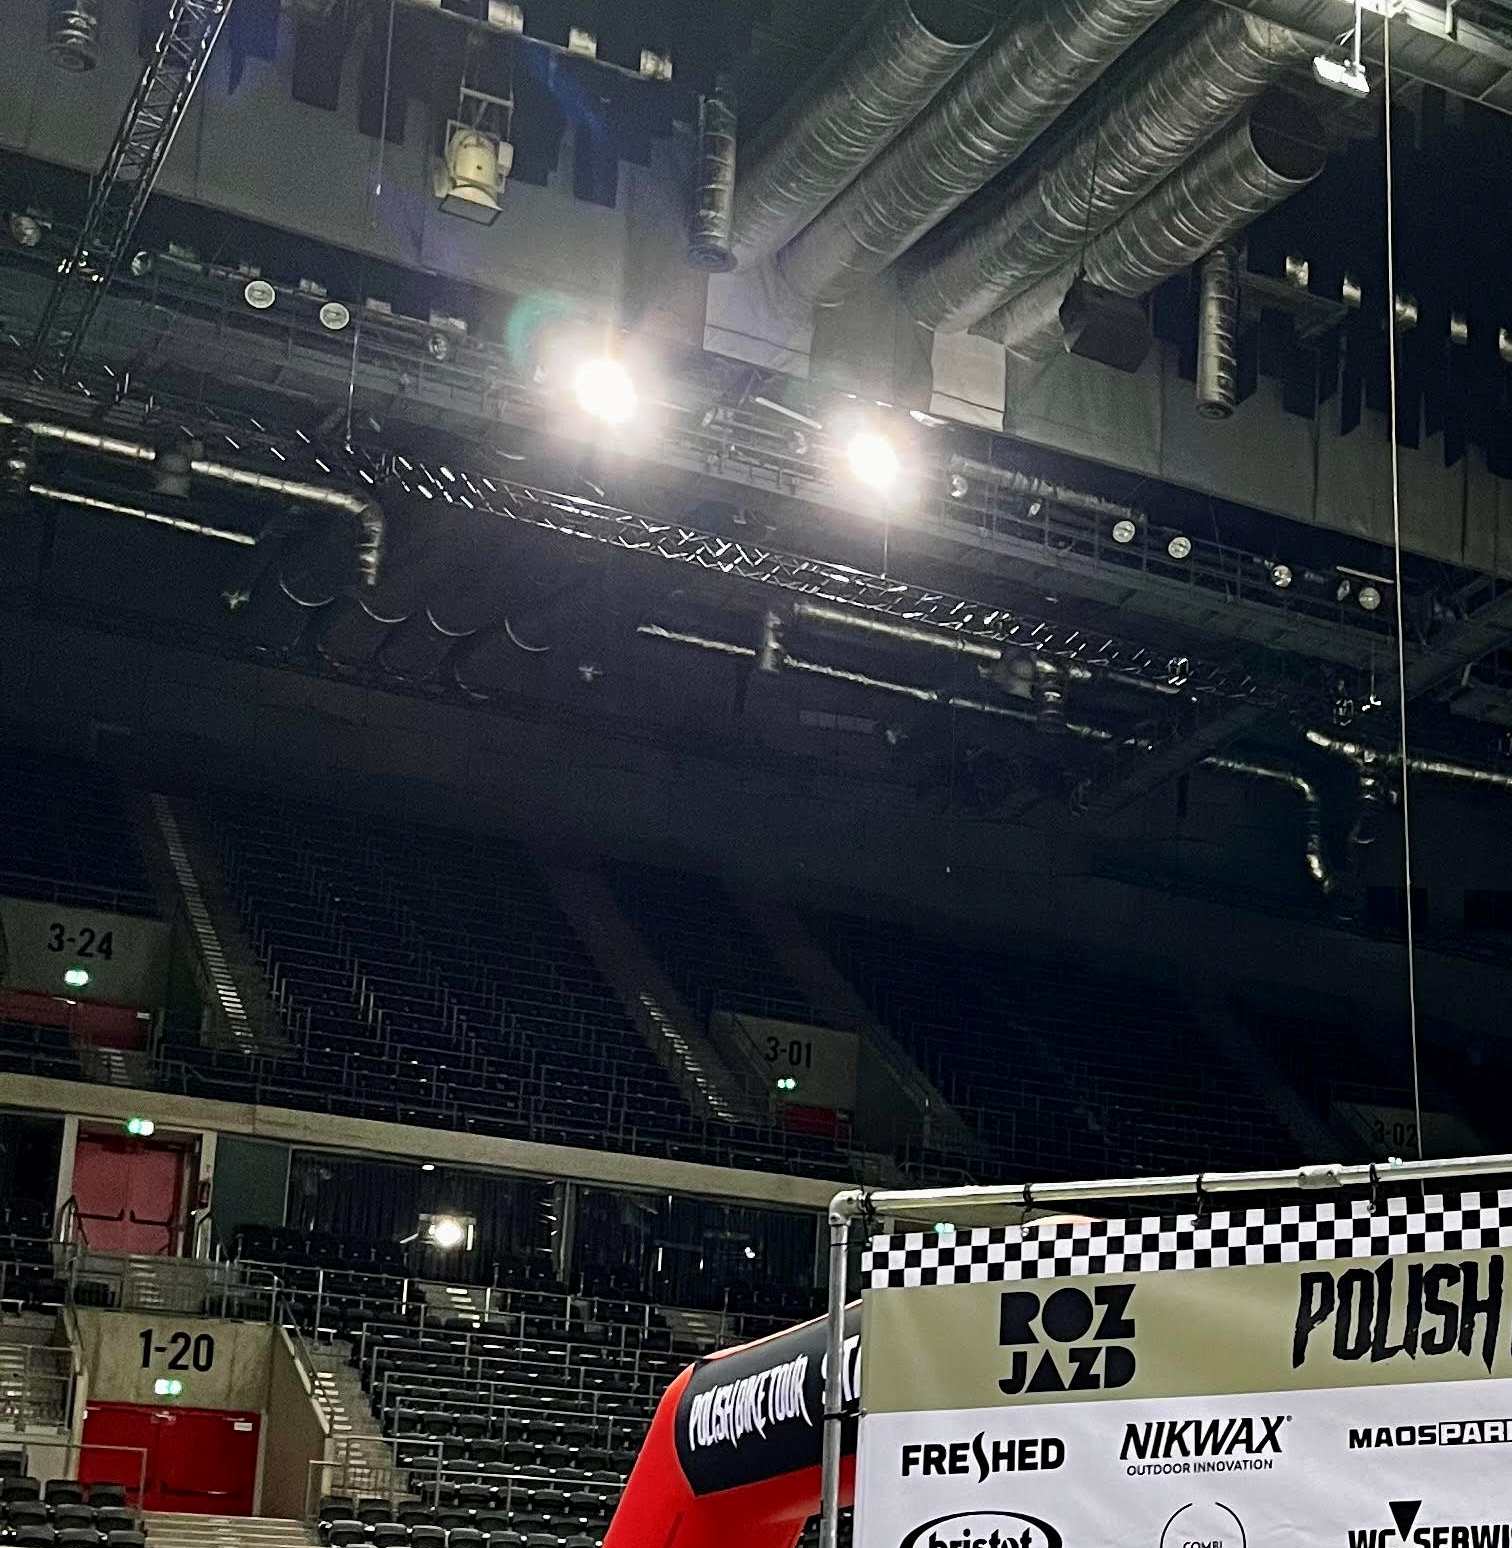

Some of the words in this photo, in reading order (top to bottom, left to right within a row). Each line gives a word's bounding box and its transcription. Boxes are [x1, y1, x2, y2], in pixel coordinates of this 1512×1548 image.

[47, 923, 112, 960] 3-24
[764, 1036, 812, 1068] 3-01
[1000, 1284, 1136, 1346] ROZ
[1293, 1255, 1504, 1374] POLISH
[140, 1329, 214, 1372] 1-20
[999, 1347, 1135, 1395] JAZD
[902, 1432, 1064, 1483] FRESHED
[1119, 1415, 1285, 1460] NIKWAX
[1127, 1463, 1190, 1476] OUTDOOR
[1194, 1459, 1272, 1472] INNOVATION
